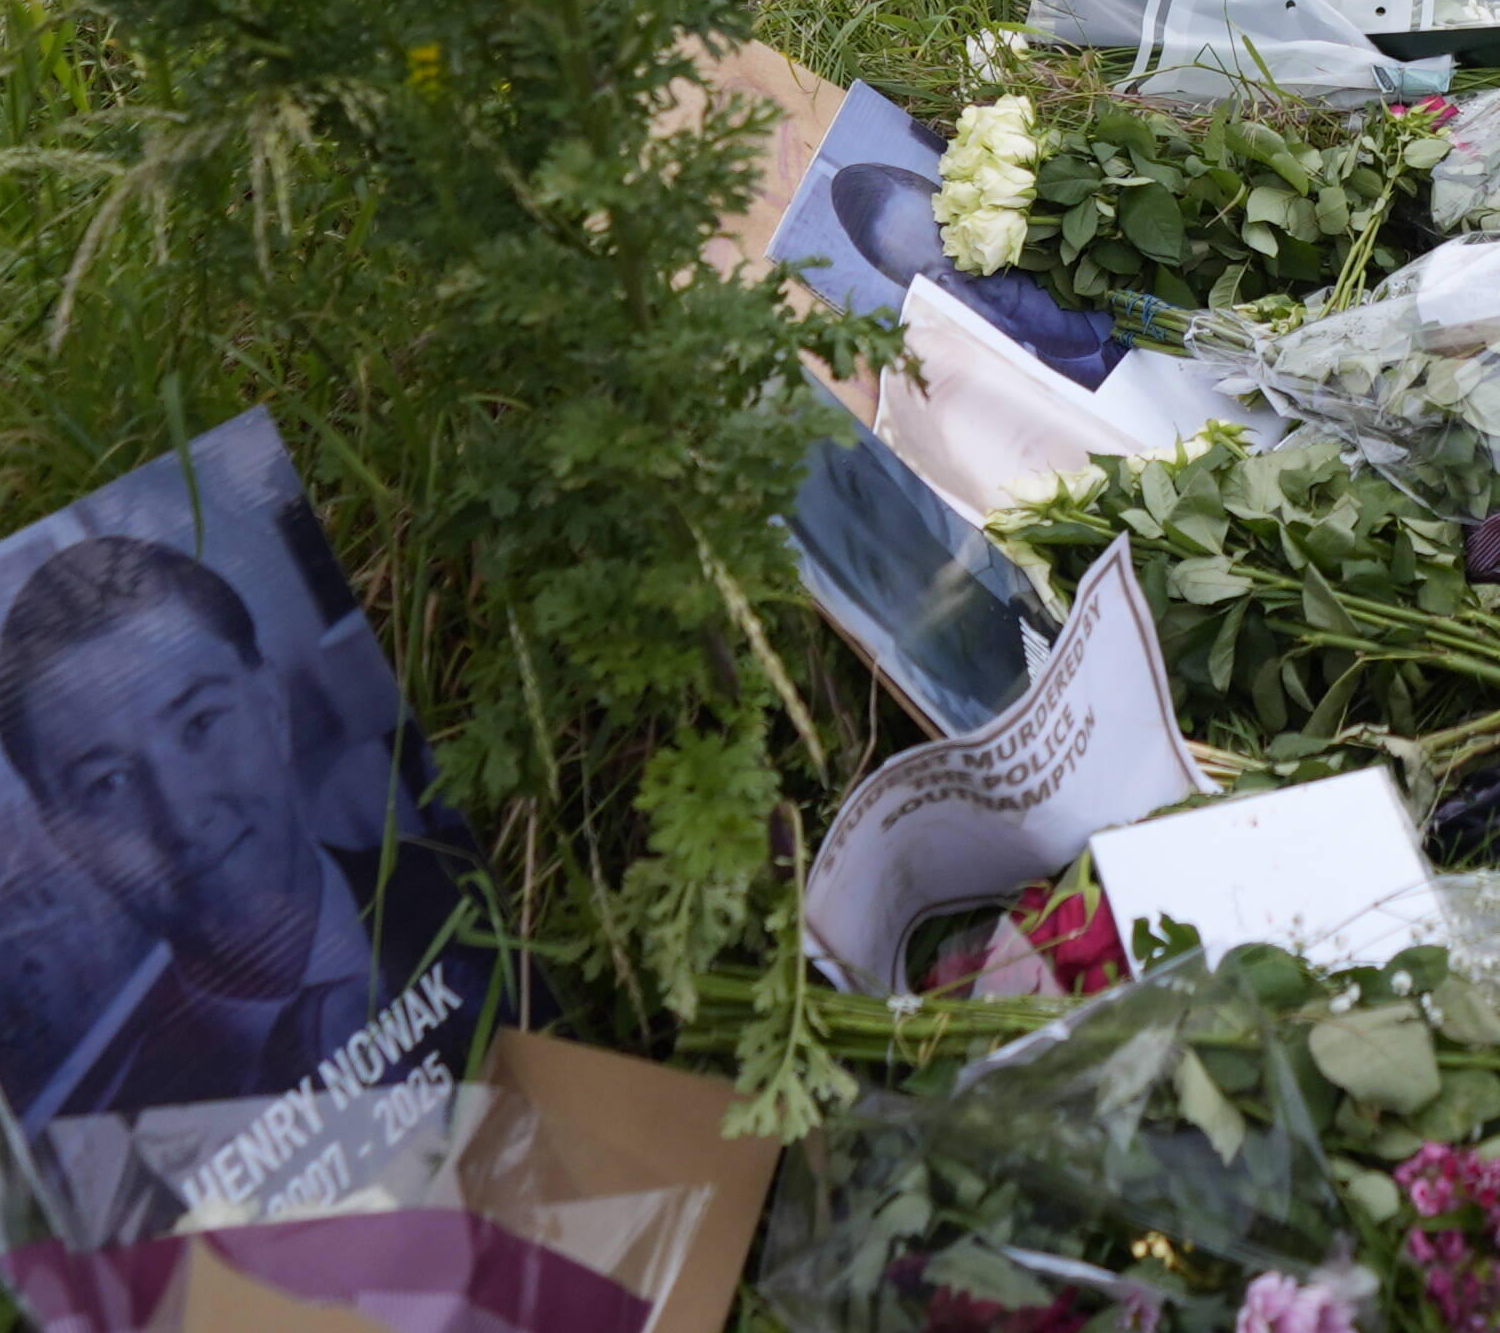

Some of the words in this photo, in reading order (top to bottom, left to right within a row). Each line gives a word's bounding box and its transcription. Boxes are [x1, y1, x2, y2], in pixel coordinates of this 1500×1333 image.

[962, 637, 1085, 771] MURDERED
[1082, 592, 1102, 641] BY
[881, 704, 1098, 831] SOUTHAMPTON
[981, 703, 1075, 791] POLICE
[181, 1075, 325, 1211] HENRY
[317, 961, 464, 1112] NOWAK
[372, 1049, 455, 1147] 2025
